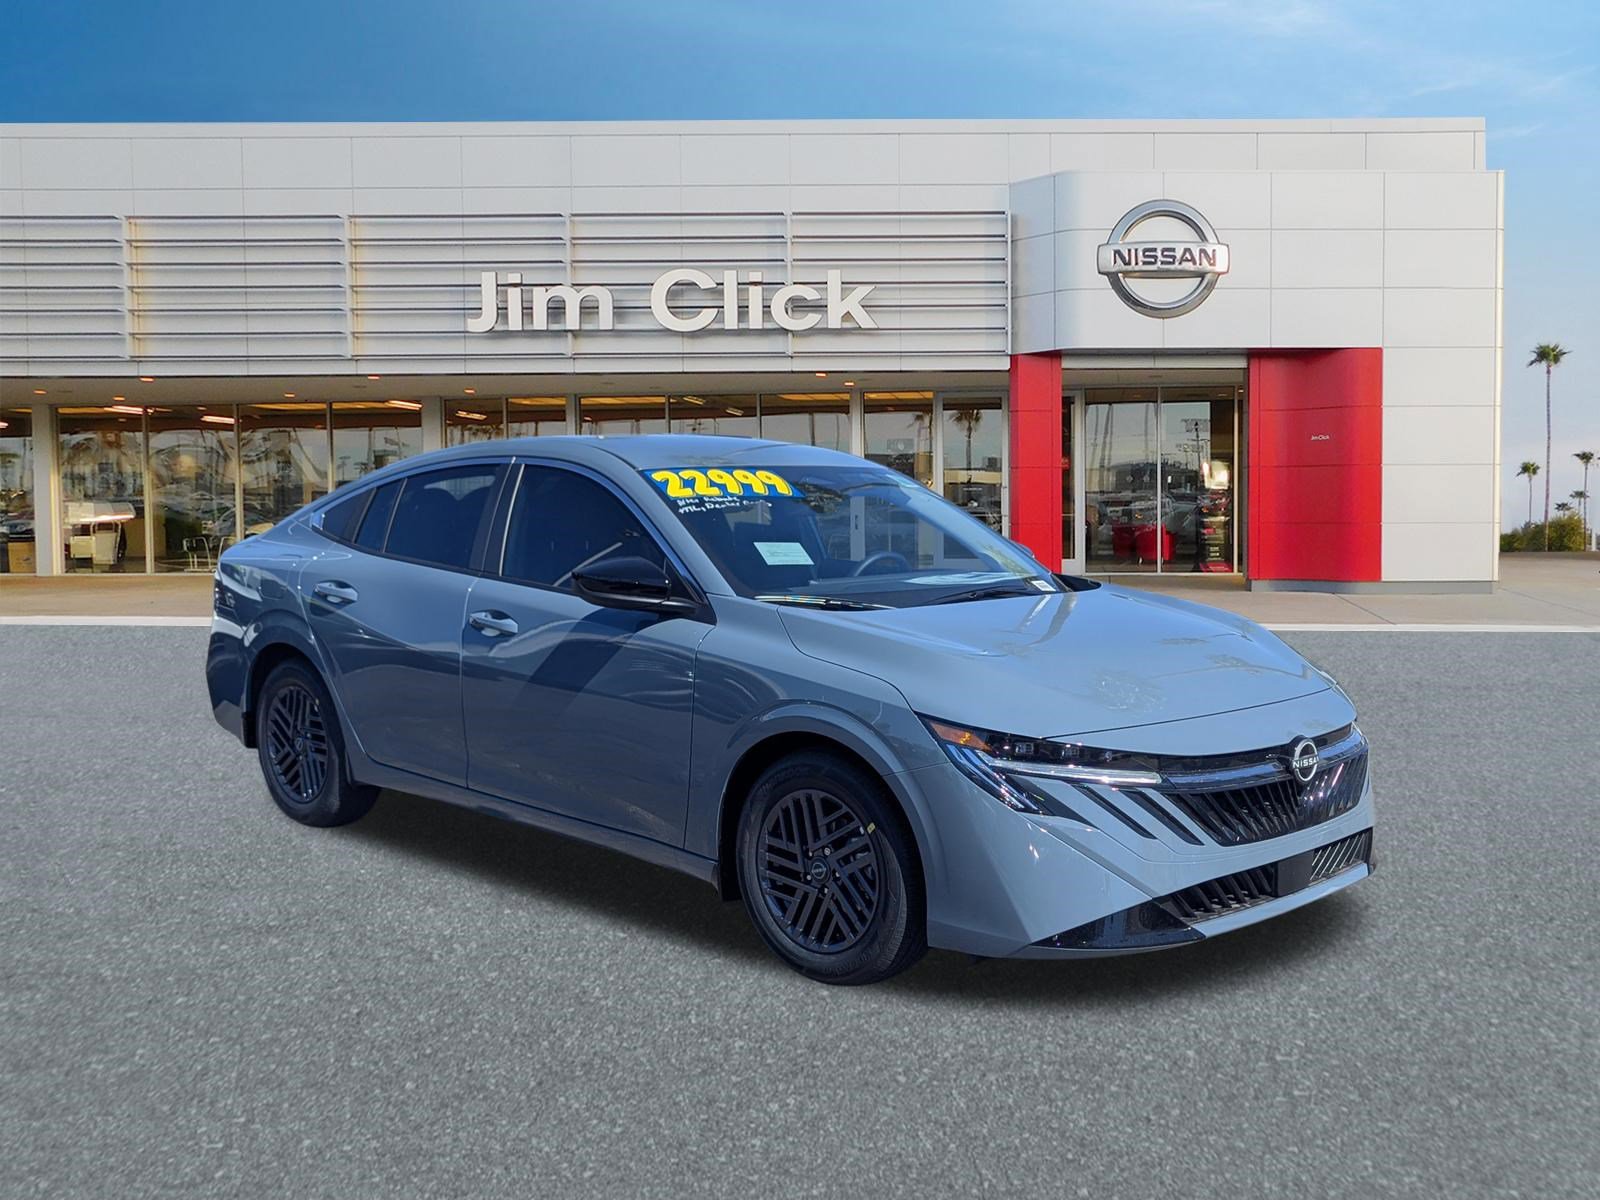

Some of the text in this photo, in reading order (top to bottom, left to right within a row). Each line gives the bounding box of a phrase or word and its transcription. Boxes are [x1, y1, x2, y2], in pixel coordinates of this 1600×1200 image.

[1113, 247, 1217, 267] NISSAN
[467, 268, 880, 333] Jim Click
[651, 469, 792, 497] 22999
